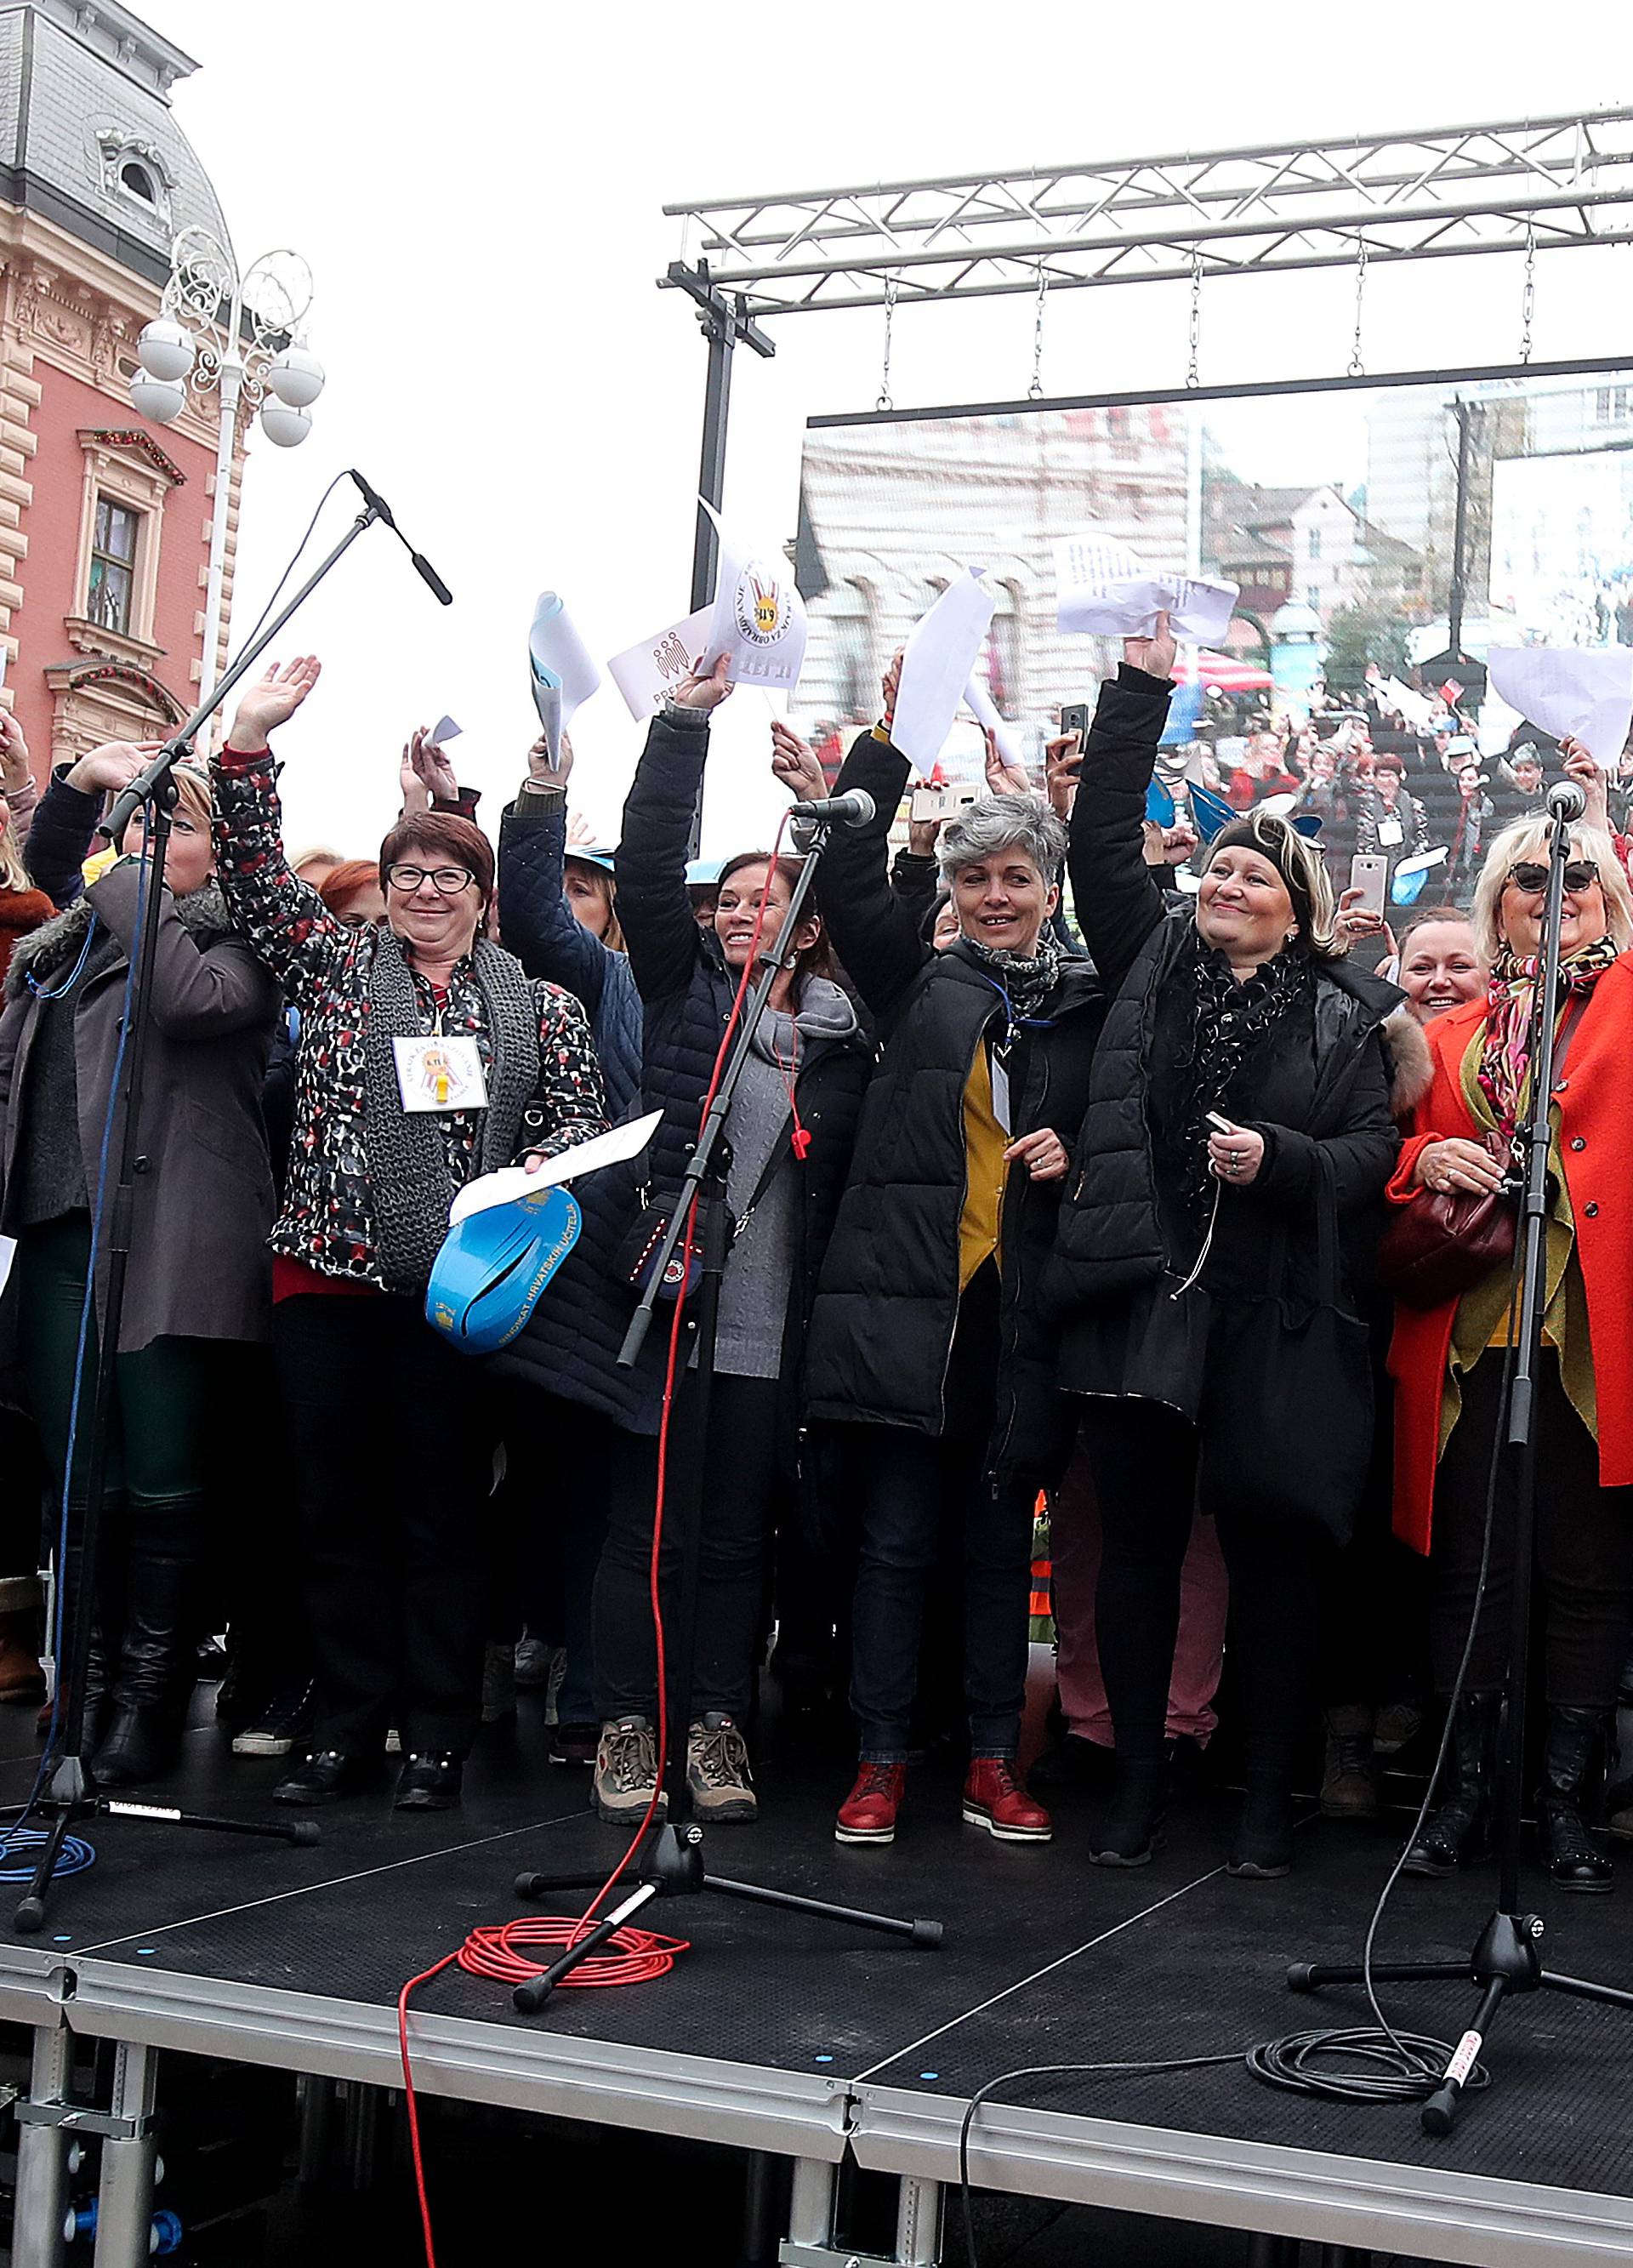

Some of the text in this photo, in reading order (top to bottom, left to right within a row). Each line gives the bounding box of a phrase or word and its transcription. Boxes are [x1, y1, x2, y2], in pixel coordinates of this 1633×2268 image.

[498, 1202, 578, 1345] SINDIKAT HRVATSKIH UČITELJA
